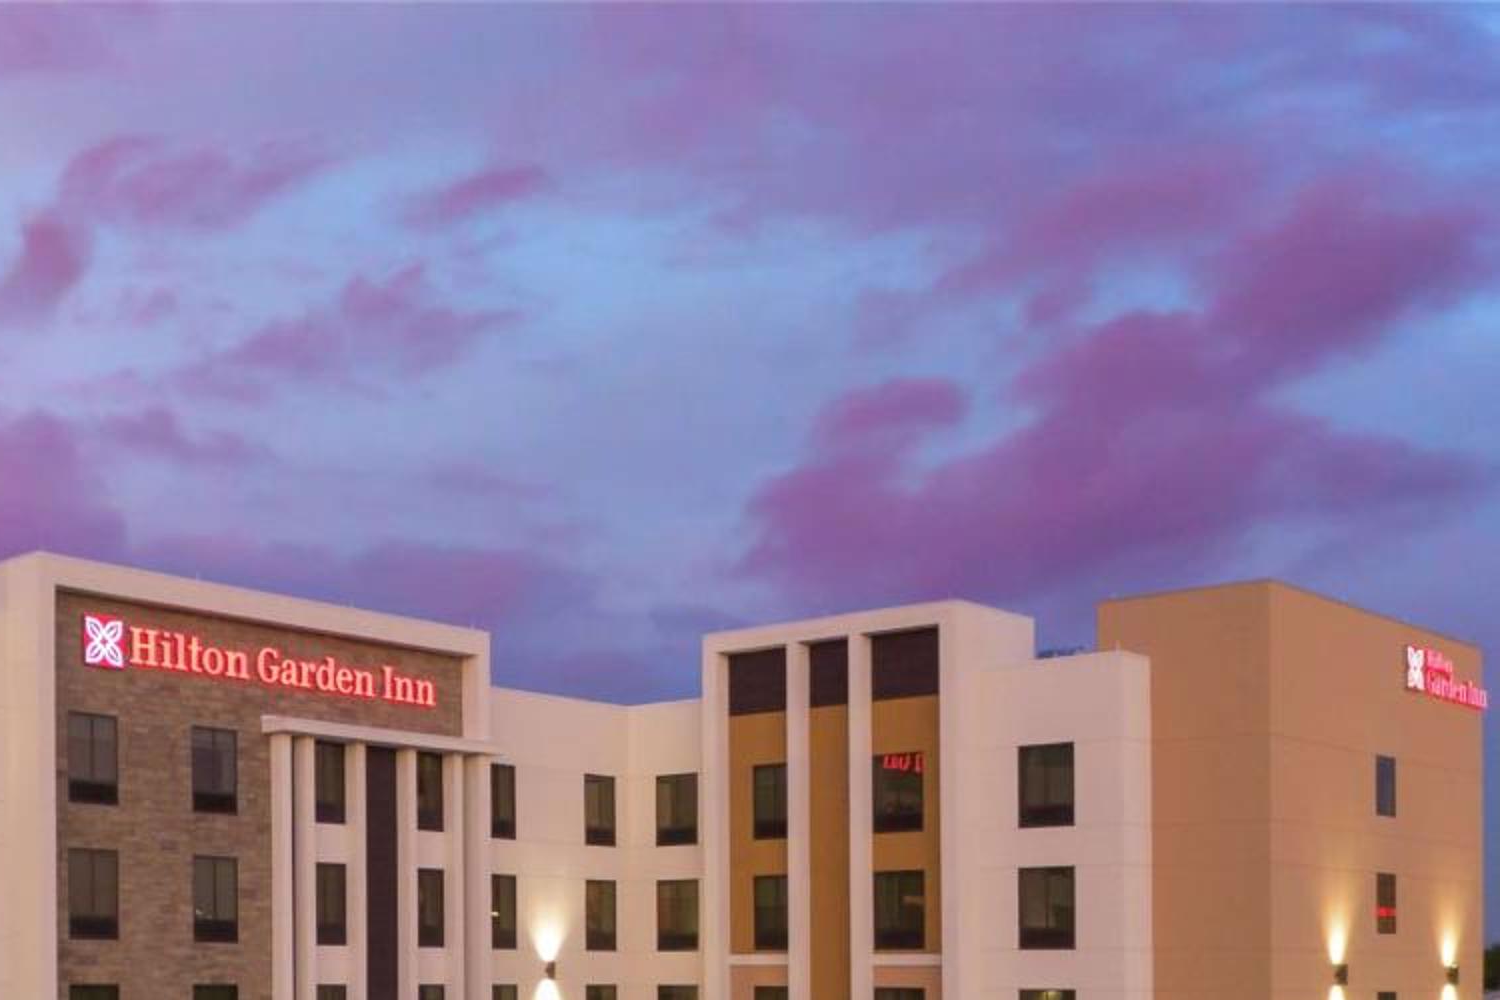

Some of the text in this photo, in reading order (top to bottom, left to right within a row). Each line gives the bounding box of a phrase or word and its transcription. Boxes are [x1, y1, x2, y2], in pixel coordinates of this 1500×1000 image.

[129, 625, 437, 706] Hilton Garden Inn
